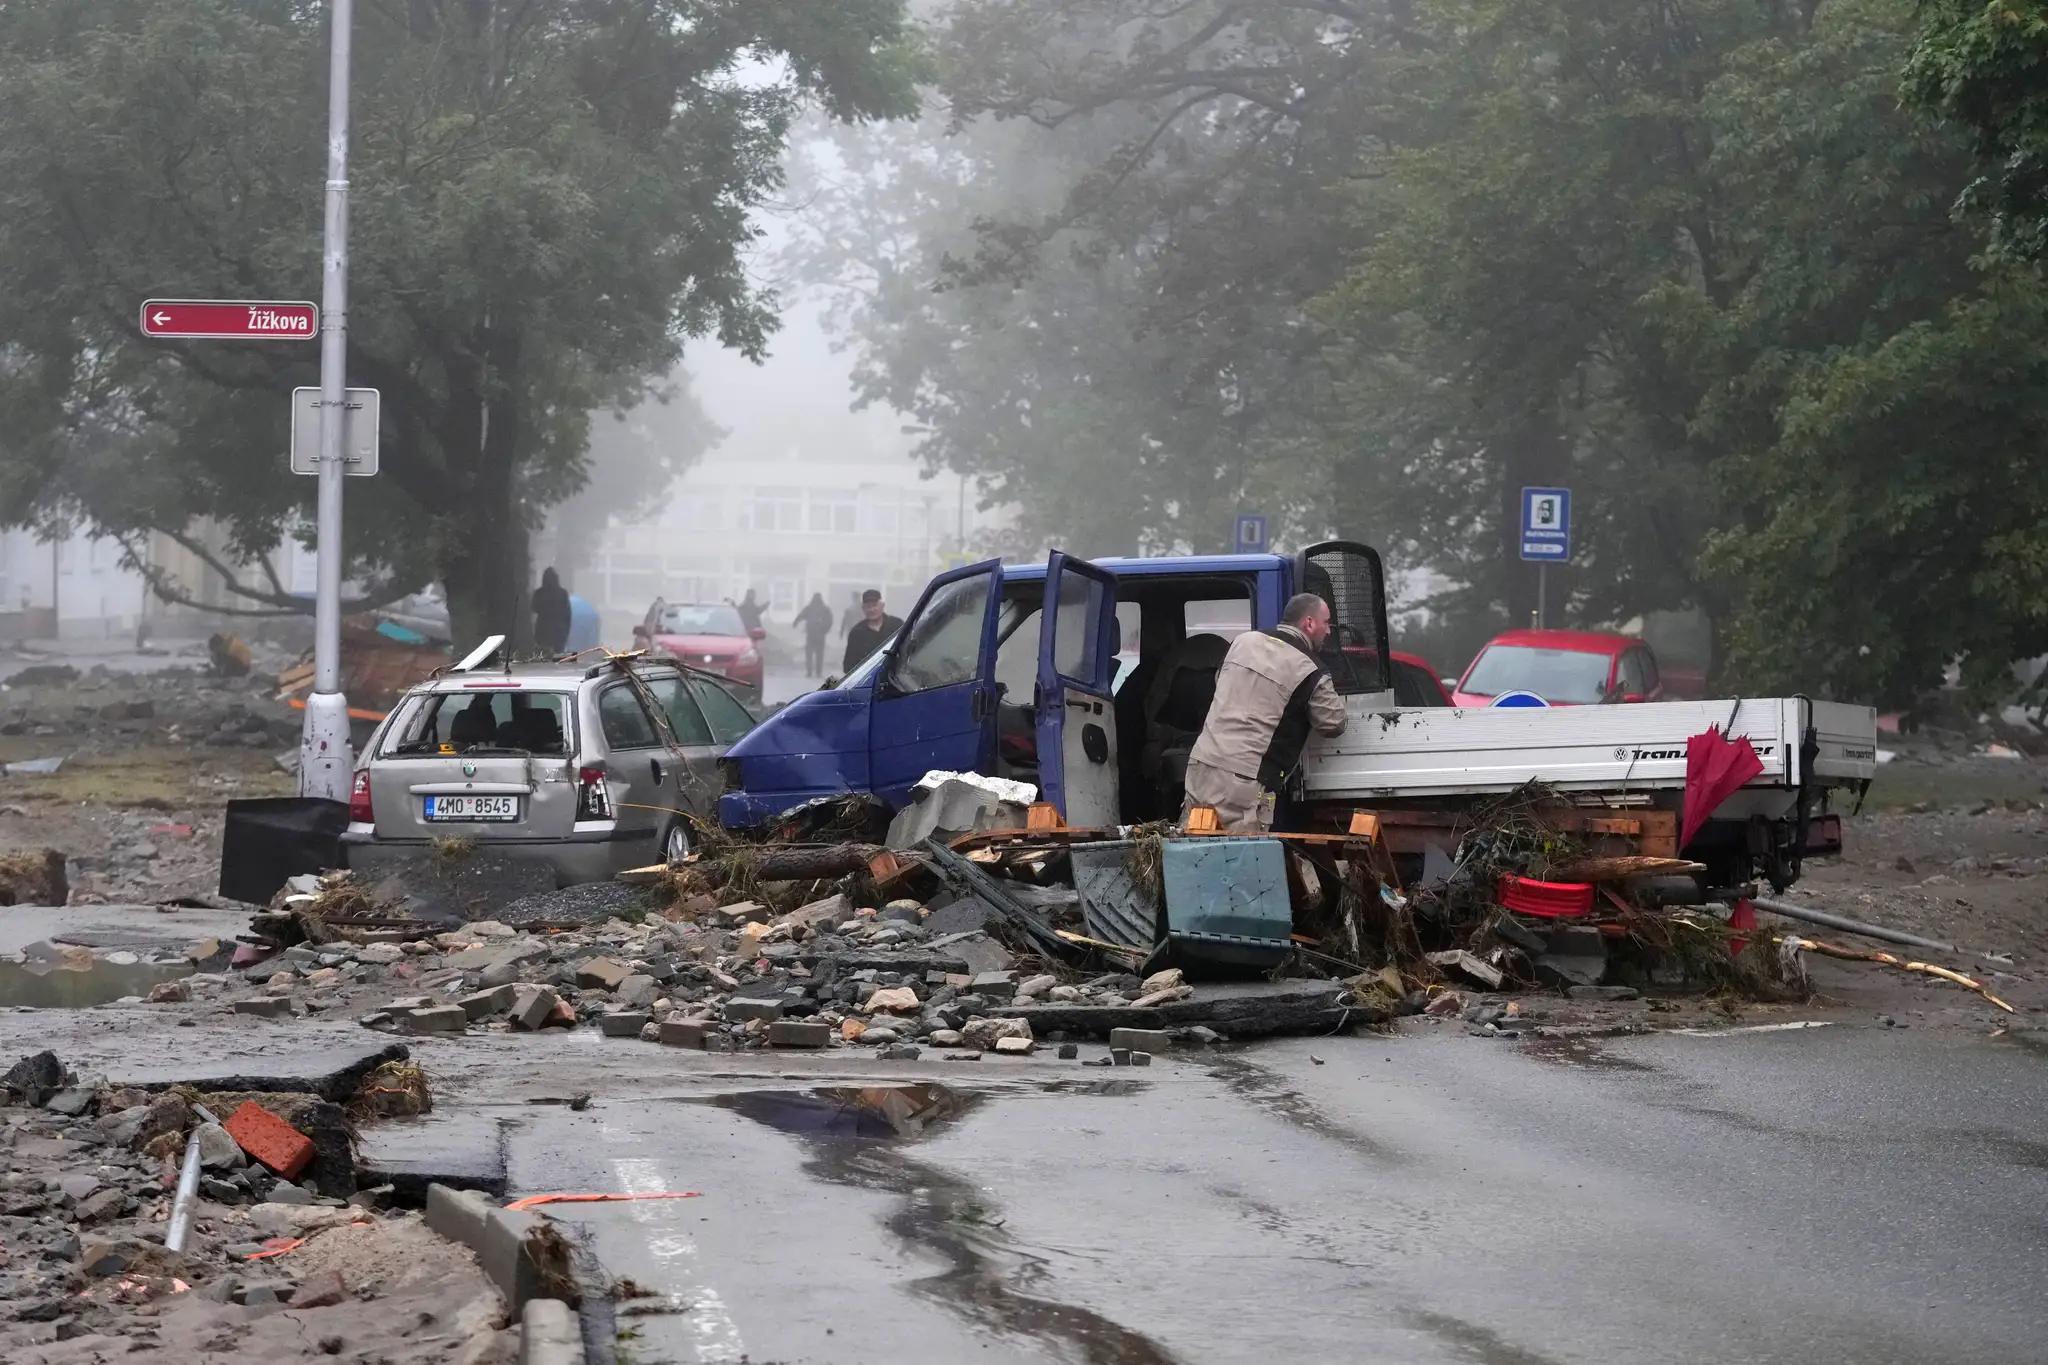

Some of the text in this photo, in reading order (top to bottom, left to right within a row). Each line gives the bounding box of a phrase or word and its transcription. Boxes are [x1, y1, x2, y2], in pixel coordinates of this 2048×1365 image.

[248, 304, 308, 330] Žižkova
[1631, 746, 1775, 760] Traner
[475, 798, 511, 814] 8545
